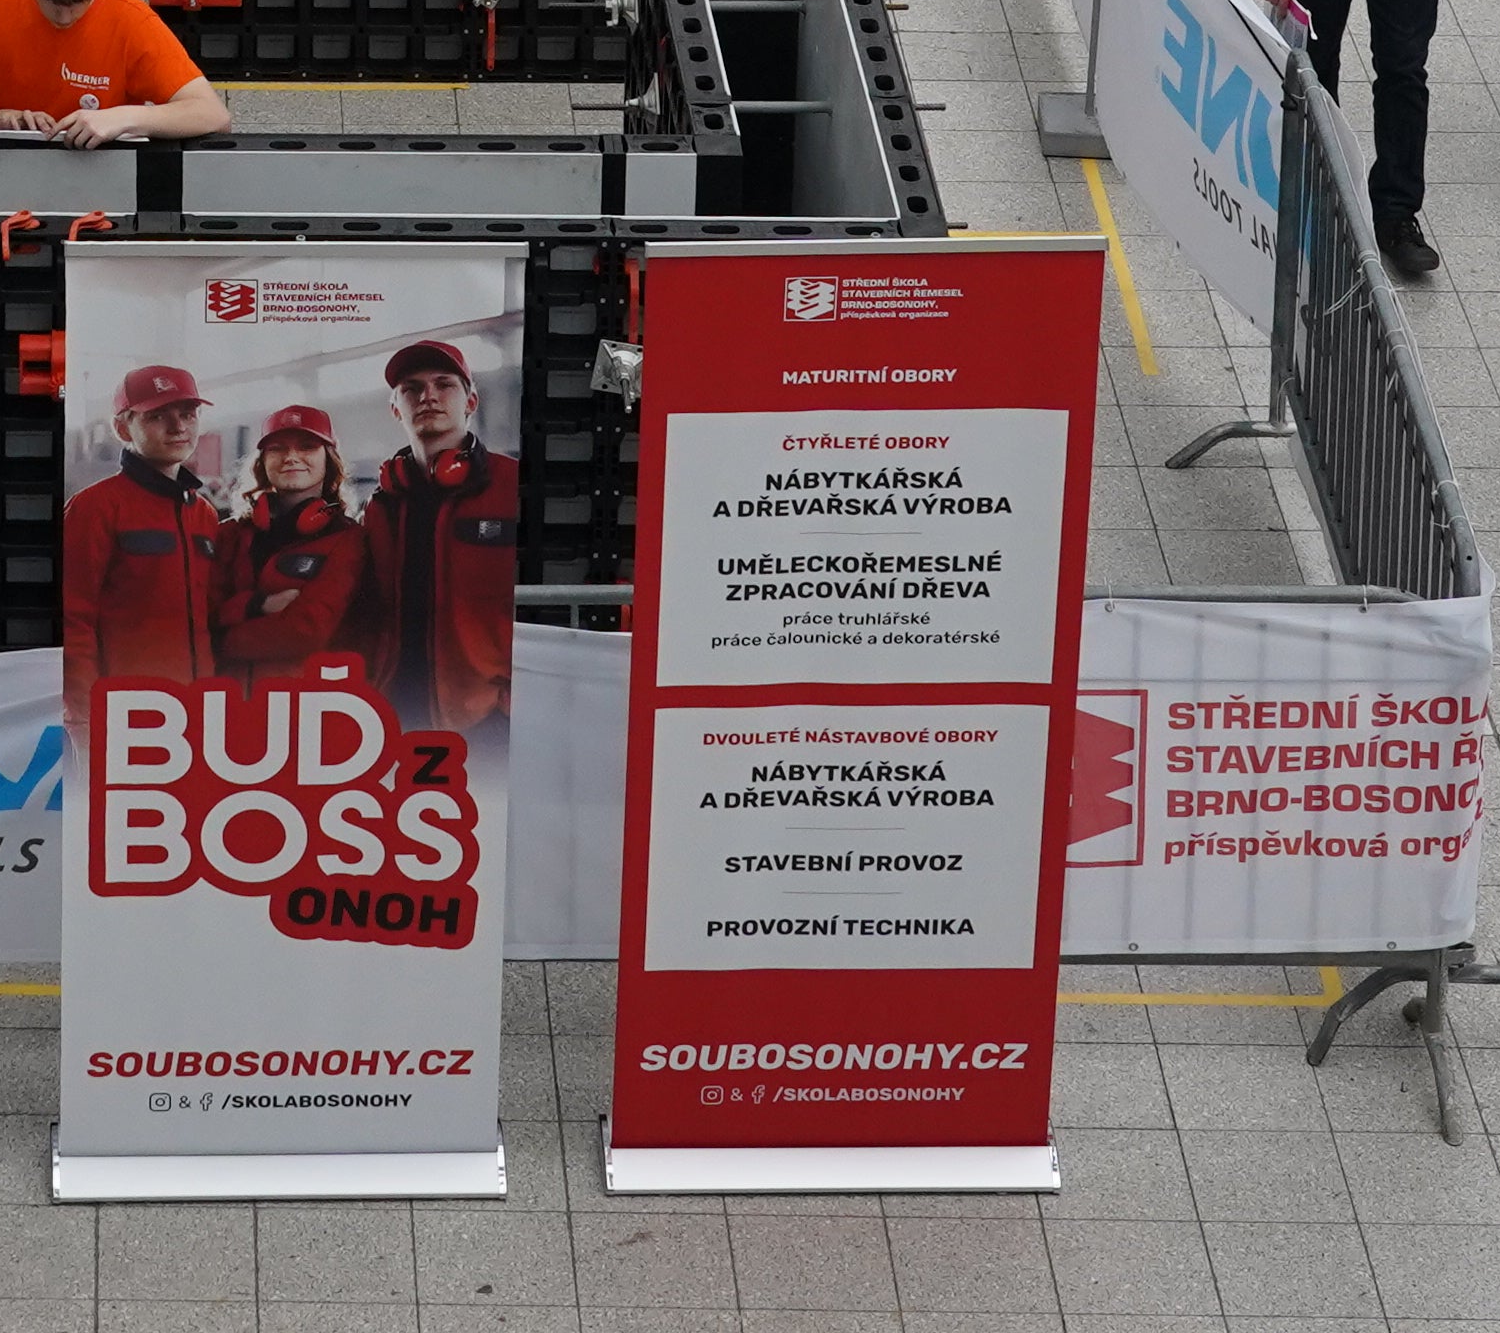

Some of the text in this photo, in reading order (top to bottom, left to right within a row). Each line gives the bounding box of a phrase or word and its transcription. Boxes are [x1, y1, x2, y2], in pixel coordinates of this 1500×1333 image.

[69, 71, 111, 86] BERNER
[782, 365, 958, 385] MATURITNÍ OBORY
[781, 432, 951, 452] ČTYŘLETÉ OBORY
[765, 465, 964, 492] NÁBYTKÁŘSKÁ
[712, 492, 1013, 518] A DŘEVAŘSKÁ VÝROBA
[717, 549, 1003, 576] UMĚLECKOŘEMESLNÉ
[725, 576, 991, 602] ZPRACOVÁNÍ DŘEVA
[782, 610, 931, 629] práce truhlářské
[710, 632, 763, 650] práce
[766, 630, 863, 646] čalounické
[881, 629, 1001, 645] dekoratérské
[1167, 693, 1360, 731] STŘEDNÍ
[105, 664, 389, 788] BUĎ
[411, 745, 451, 786] Z
[702, 726, 999, 746] DVOULETÉ NÁSTAVBOVÉ OBORY
[1166, 733, 1441, 775] STAVEBNÍCH
[751, 759, 947, 784] NÁBYTKÁŘSKÁ
[699, 785, 995, 809] A DŘEVAŘSKÁ VÝROBA
[1166, 779, 1480, 817] BRNO-BOSONO
[105, 789, 464, 885] BOSS
[1163, 829, 1389, 866] příspěvková
[724, 850, 964, 874] STAVEBNÍ PROVOZ
[285, 883, 462, 937] ONOH
[706, 914, 975, 938] PROVOZNÍ TECHNIKA
[86, 1049, 475, 1078] SOUBOSONOHY.CZ
[639, 1042, 1029, 1072] SOUBOSONOHY.CZ
[220, 1093, 413, 1111] /SKOLABOSONOHY
[772, 1085, 966, 1103] /SKOLABOSONOHY
